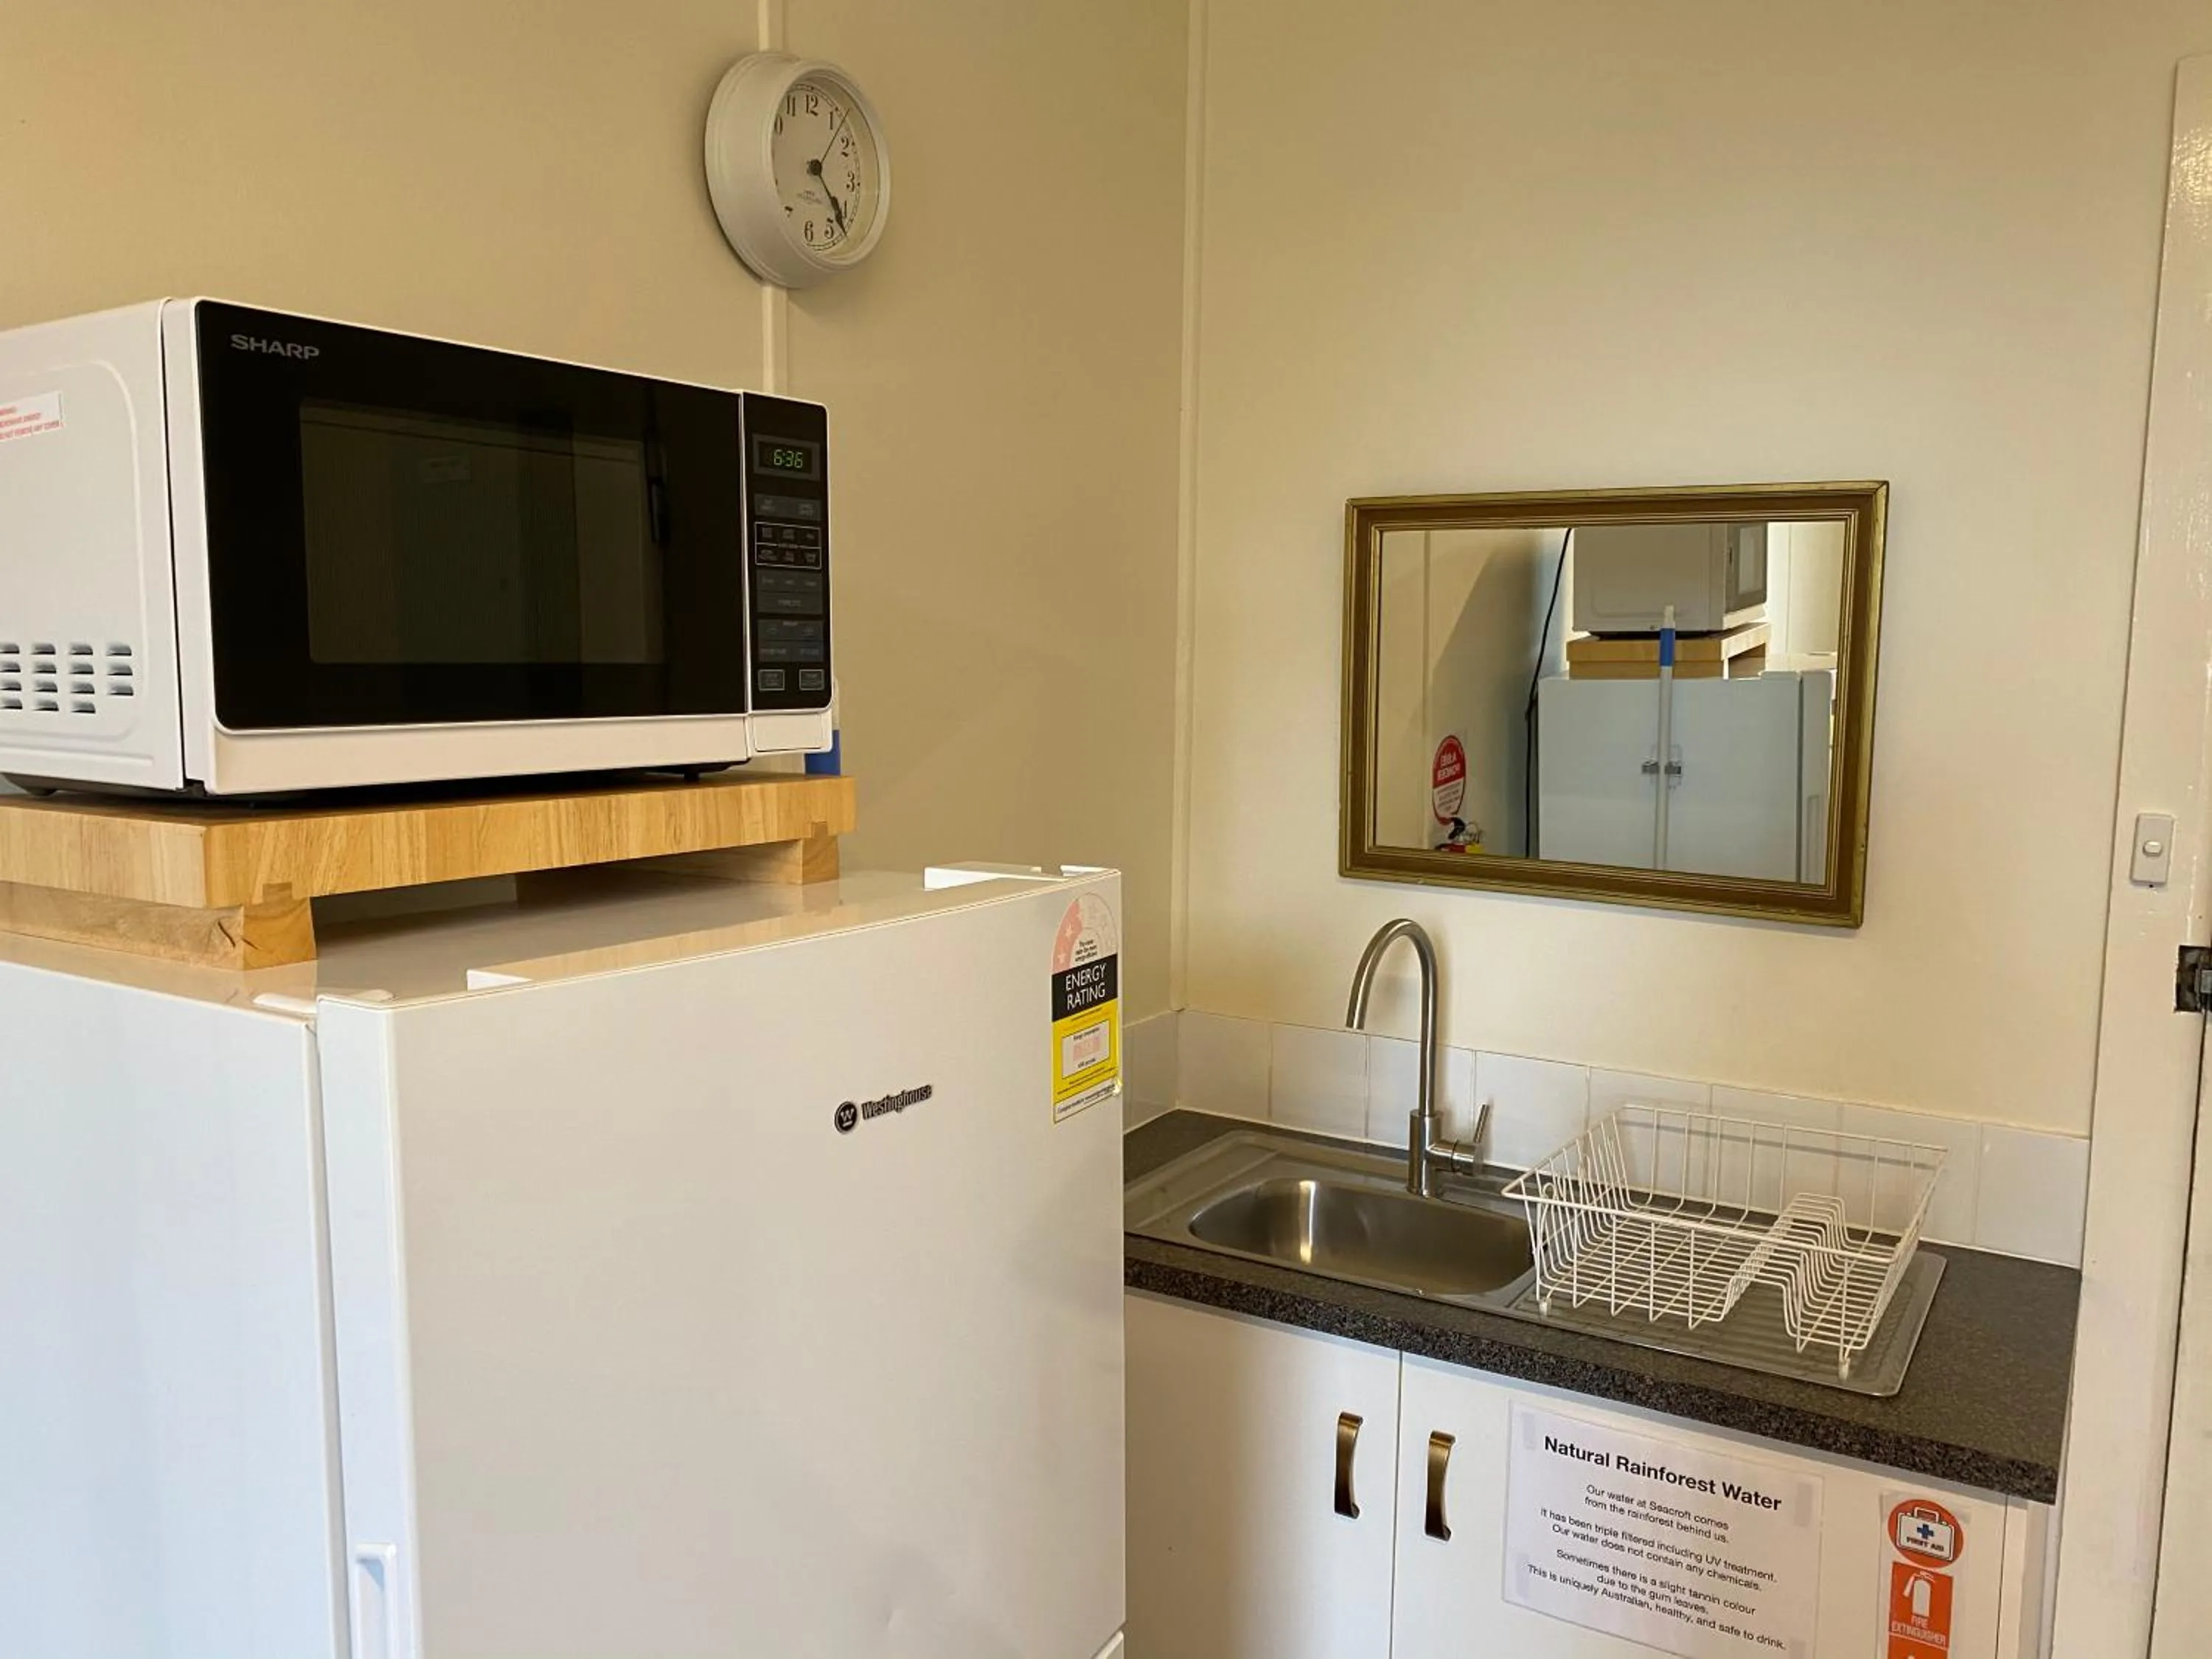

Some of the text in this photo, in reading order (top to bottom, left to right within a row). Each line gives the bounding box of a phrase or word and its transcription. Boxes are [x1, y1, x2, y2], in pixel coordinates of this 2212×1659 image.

[787, 94, 796, 116] 11
[806, 94, 818, 116] 12
[774, 115, 783, 135] 0
[830, 111, 834, 131] 1
[841, 135, 850, 157] 2
[846, 171, 855, 192] 3
[804, 220, 813, 243] 6
[824, 218, 834, 240] 5
[231, 334, 319, 360] SHARP
[1065, 962, 1107, 991] ENERGY
[1067, 982, 1105, 1011] RATING
[861, 1084, 933, 1120] Westinghouse
[1545, 1436, 1782, 1510] Natural Rainforest Water
[1585, 1497, 1729, 1543] from the rainforest behind us.
[1587, 1484, 1729, 1530] Our water at Seacroft comes
[1540, 1508, 1778, 1582] It has been triple filtered including UV treatment.
[1552, 1523, 1762, 1591] Our water does not contain any chemicals.
[1907, 1537, 1944, 1551] FIRST AID
[1557, 1549, 1756, 1615] Sometimes there is a slight tannin colour
[1597, 1575, 1708, 1615] due to the gum leaves.
[1527, 1564, 1787, 1651] This is uniquely Australian, healthy, and safe to drink.
[1891, 1620, 1946, 1647] EXTINGUISHER
[1911, 1614, 1928, 1629] FIRE
